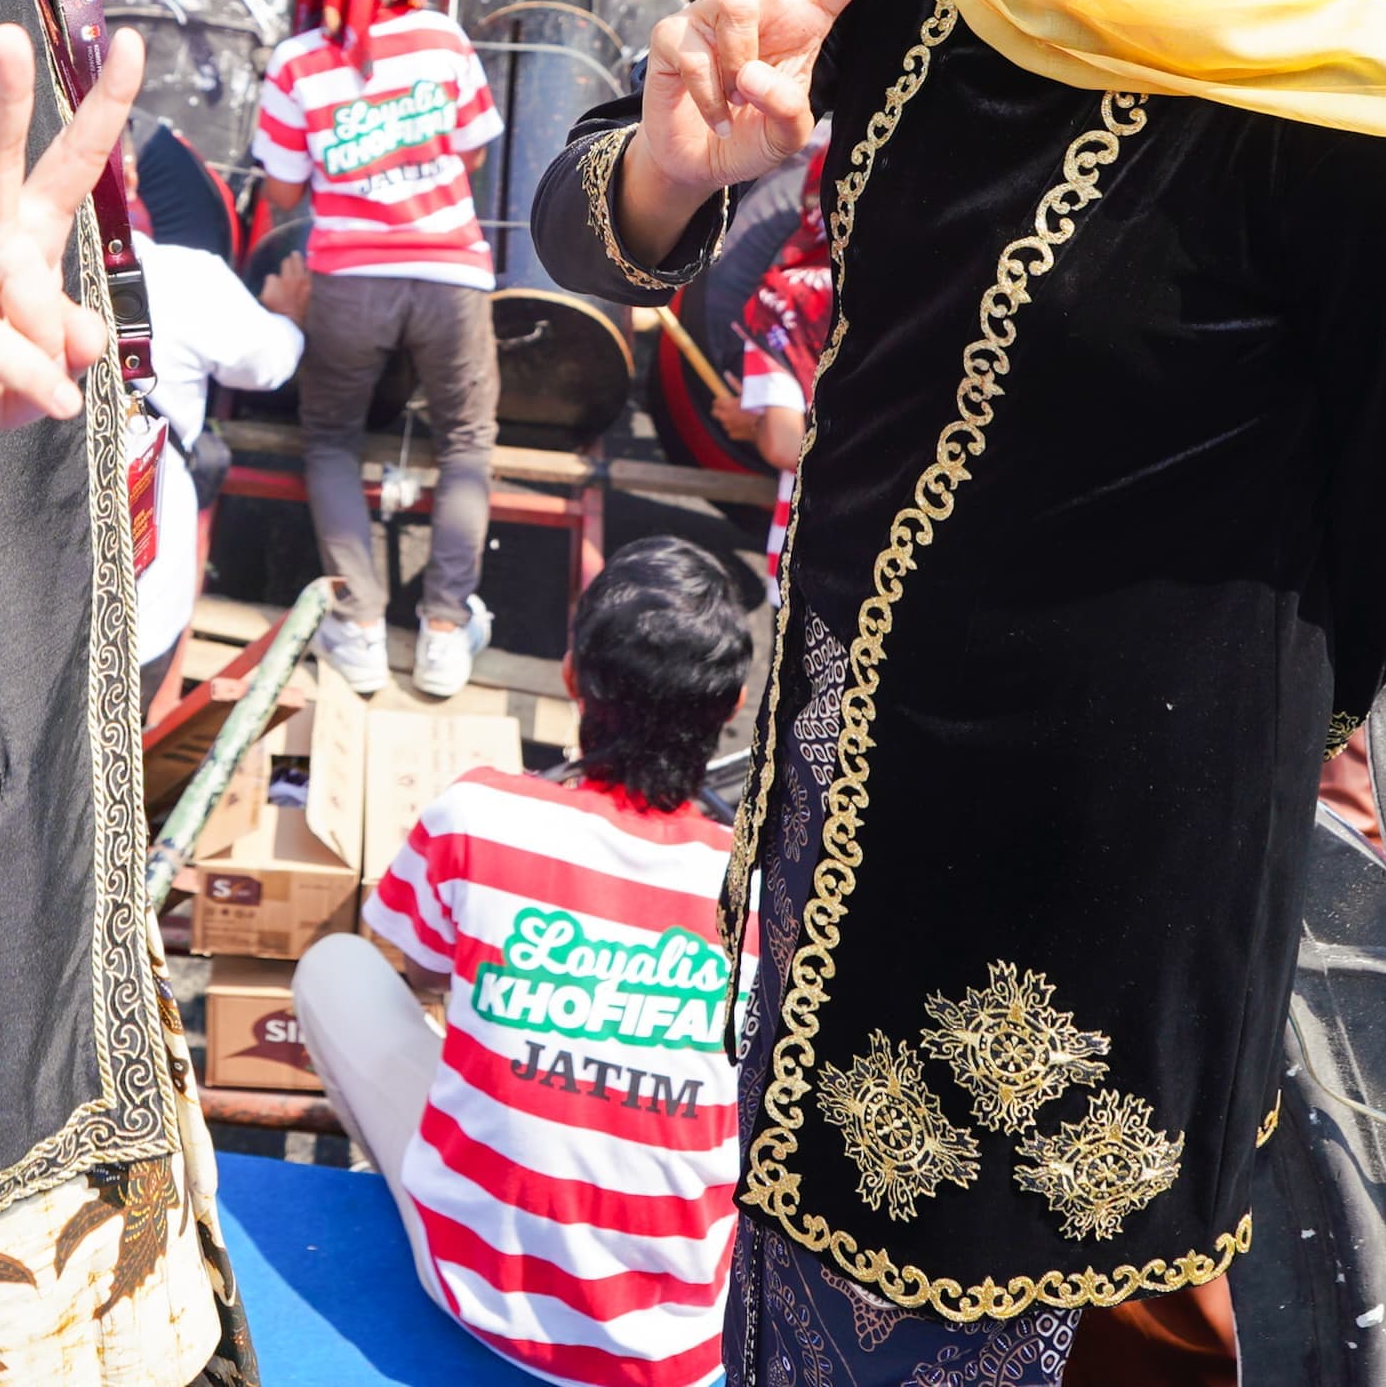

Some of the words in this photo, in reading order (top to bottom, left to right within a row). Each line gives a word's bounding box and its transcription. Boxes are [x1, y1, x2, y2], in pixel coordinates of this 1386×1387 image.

[509, 916, 727, 993] Loyalis
[265, 1019, 306, 1044] SI
[510, 1040, 704, 1119] JATIM
